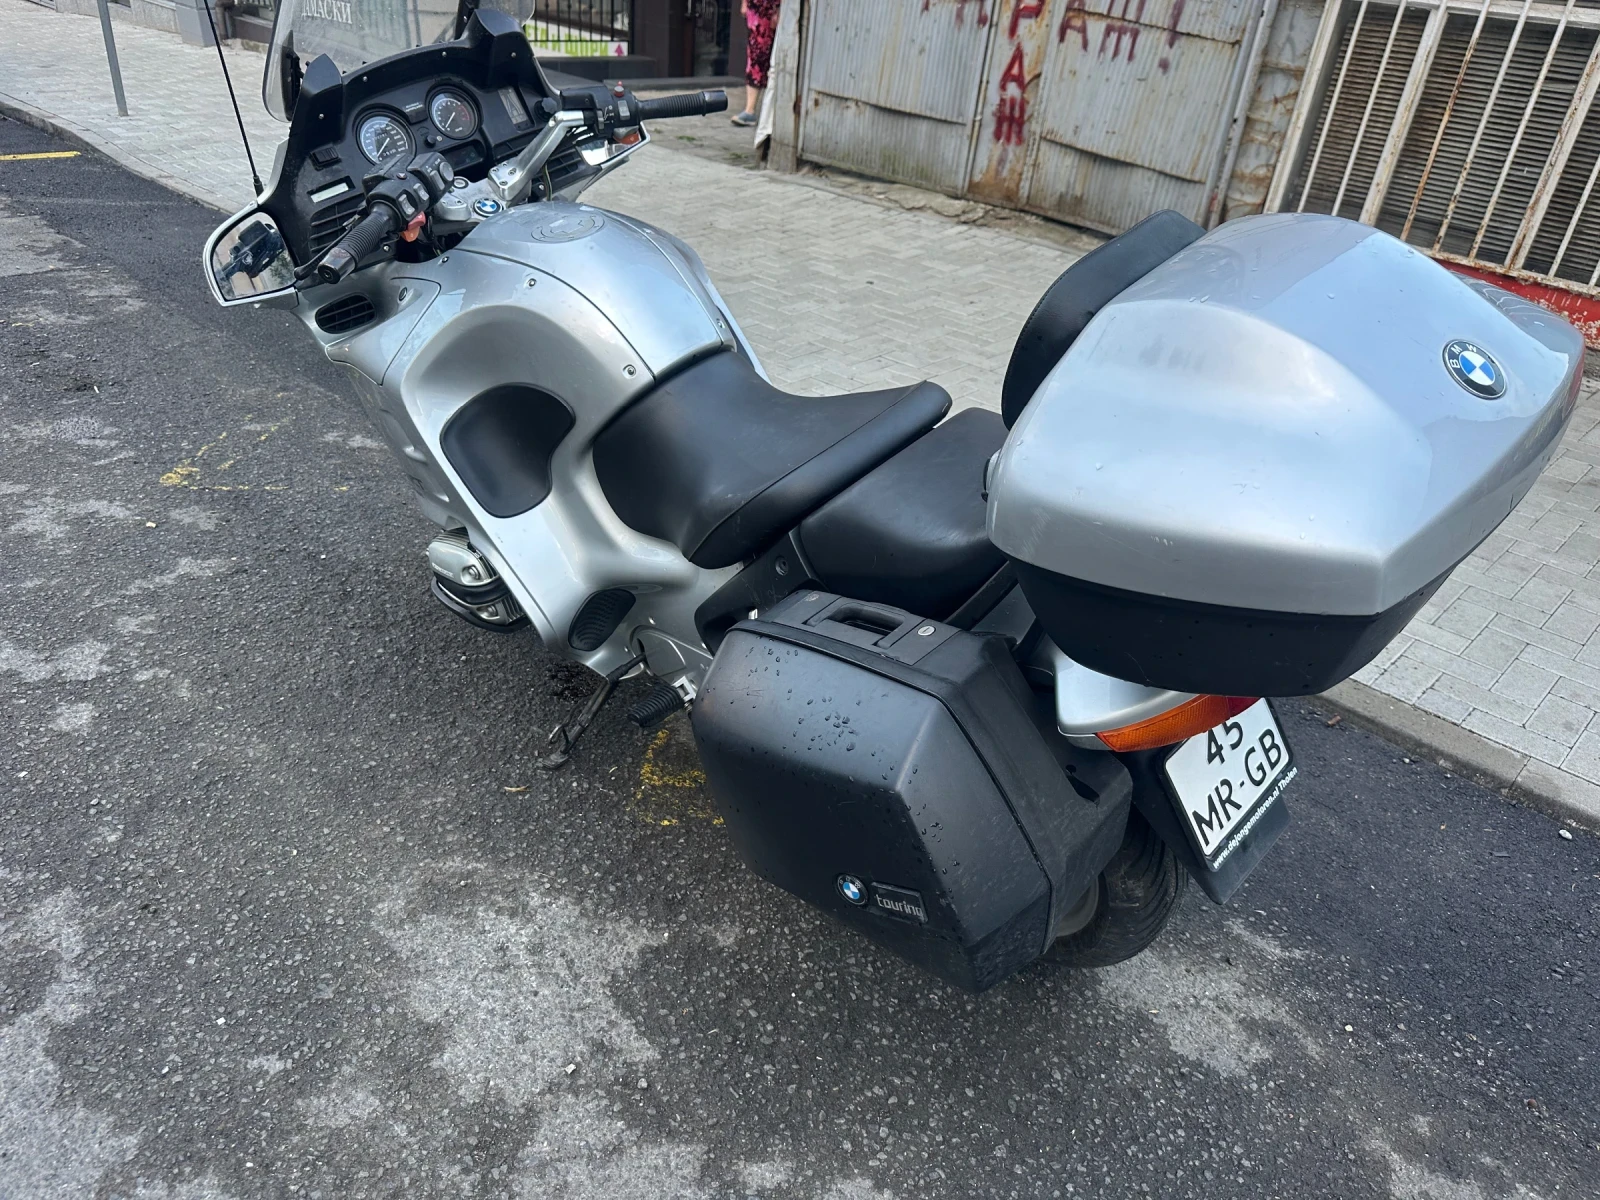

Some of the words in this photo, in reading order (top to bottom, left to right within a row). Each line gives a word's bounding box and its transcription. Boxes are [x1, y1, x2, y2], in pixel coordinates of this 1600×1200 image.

[1450, 343, 1478, 368] BMW
[1207, 721, 1243, 765] 45
[1192, 728, 1282, 847] MR-GB
[1278, 766, 1298, 794] Tholen
[875, 894, 924, 922] touring
